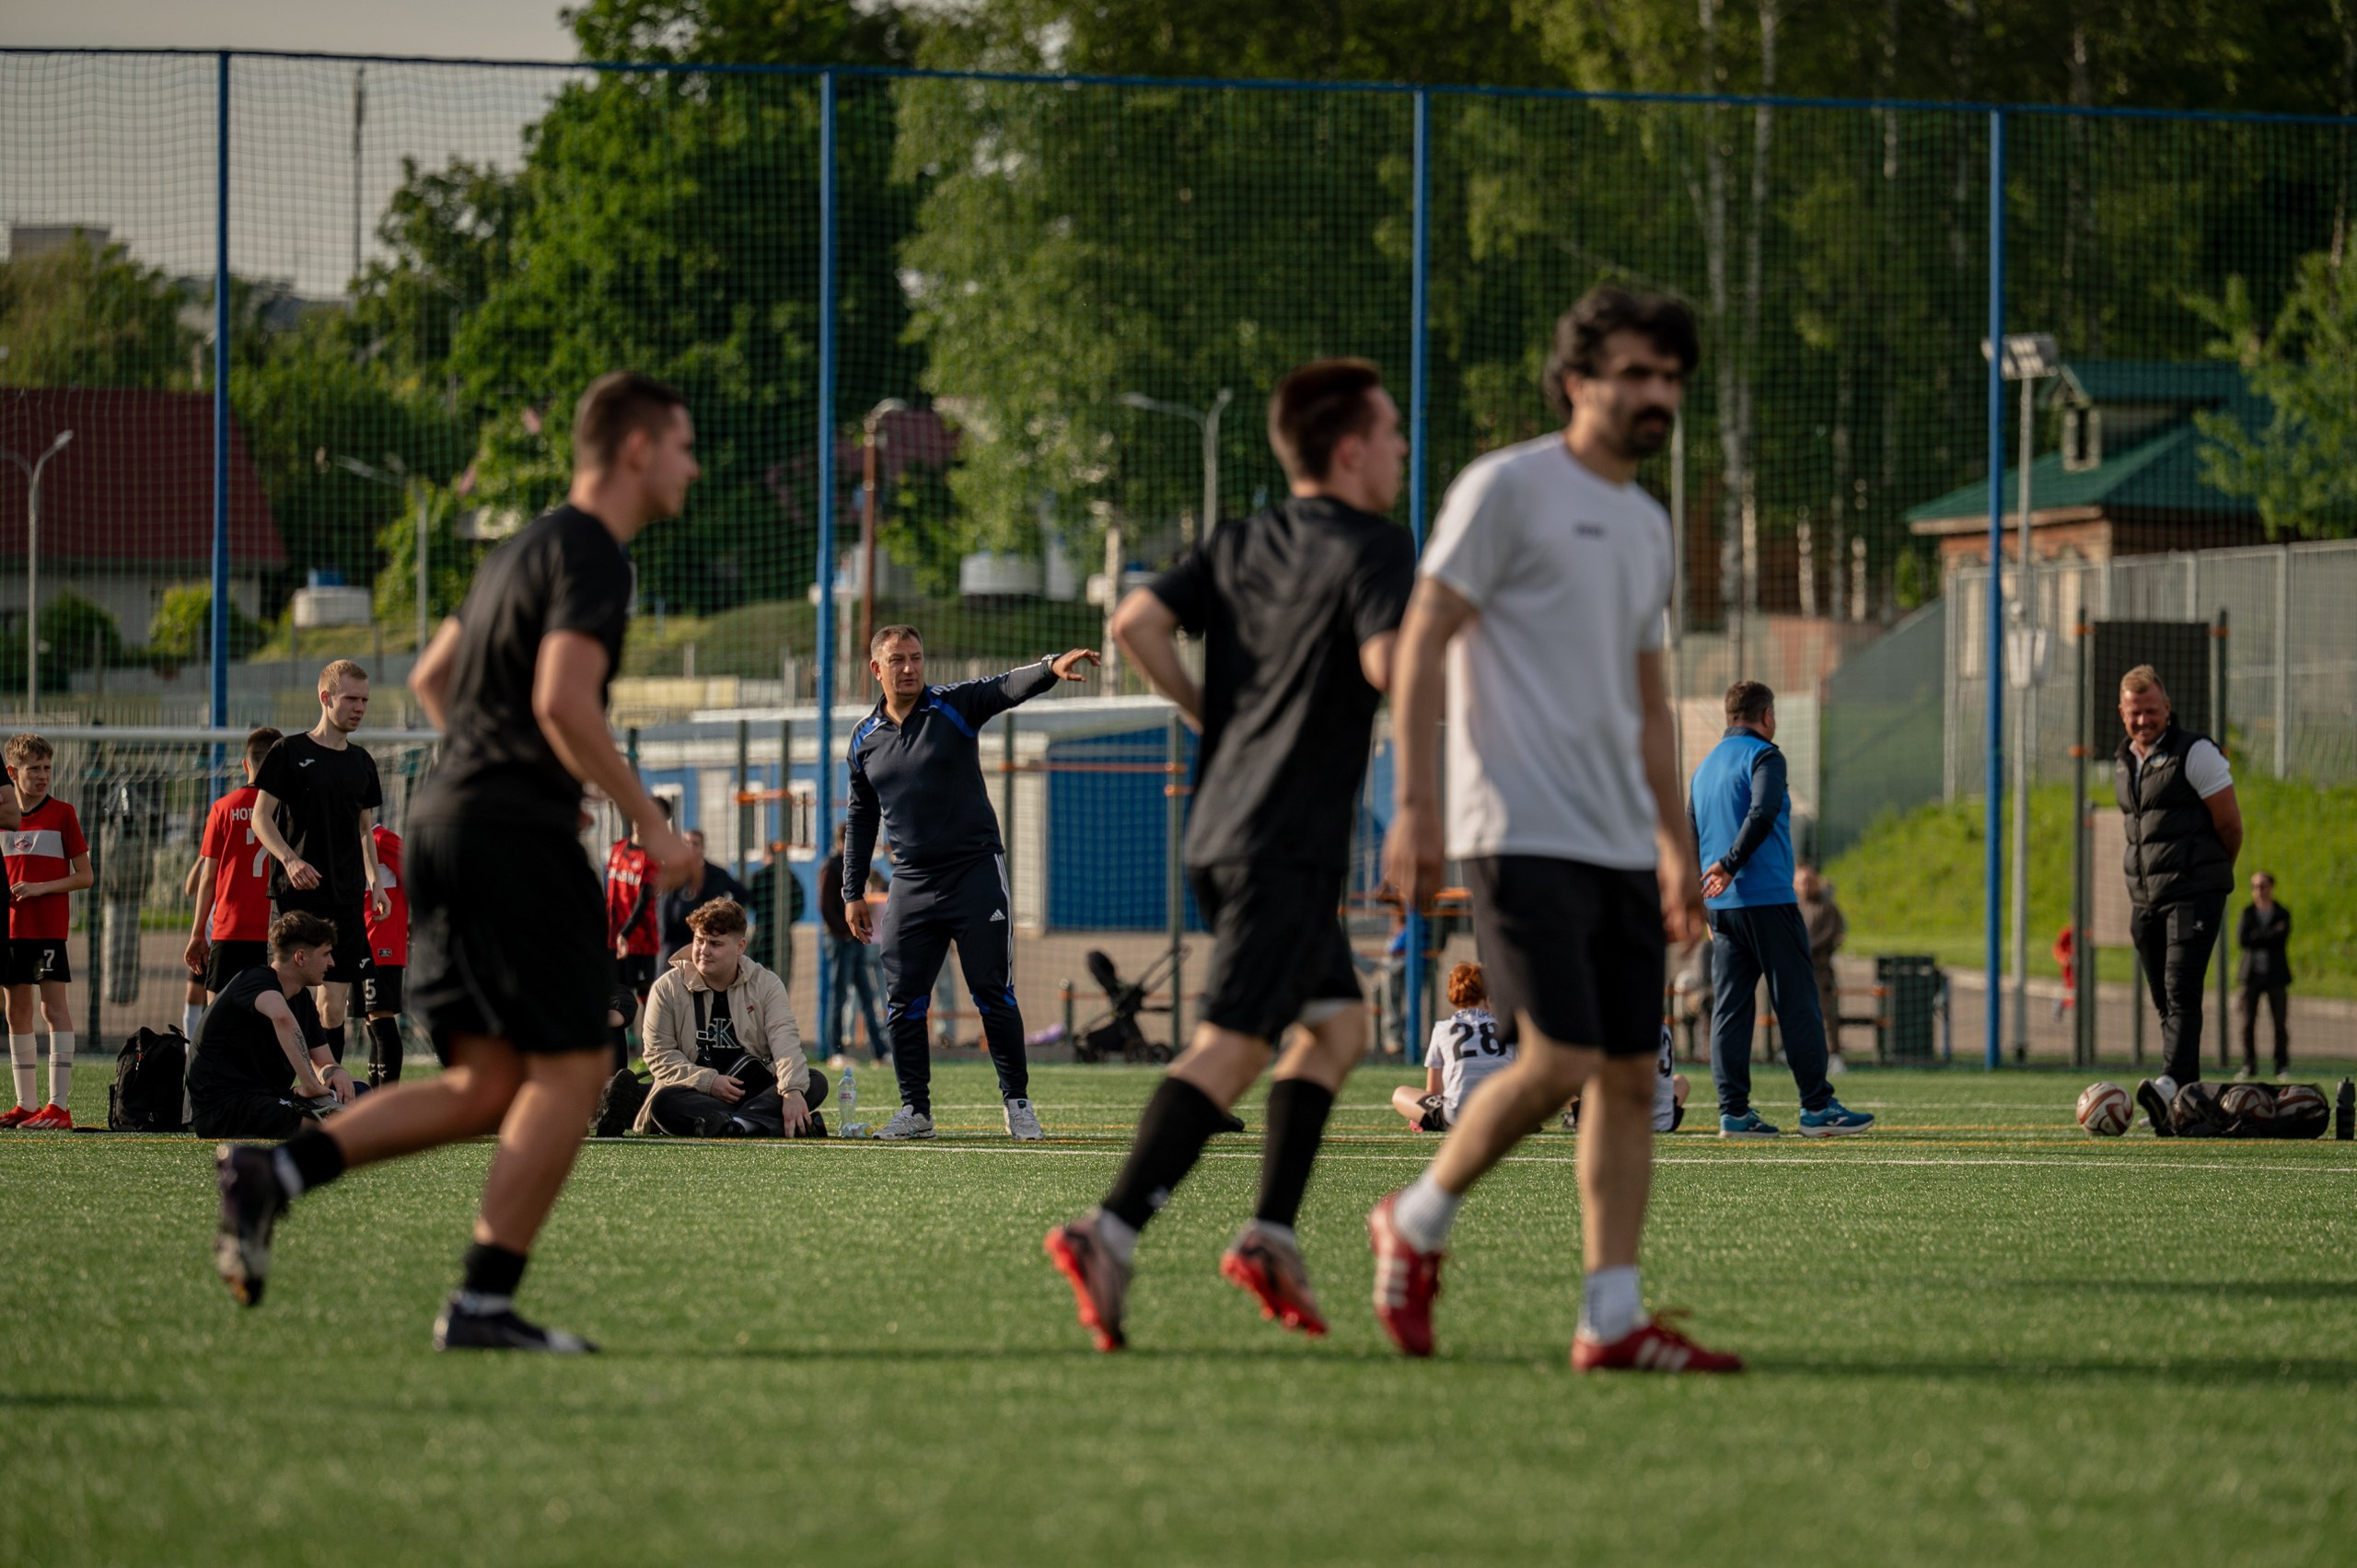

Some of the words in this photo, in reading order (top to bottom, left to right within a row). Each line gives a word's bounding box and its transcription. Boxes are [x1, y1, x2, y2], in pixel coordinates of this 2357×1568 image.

[246, 827, 270, 877] 7
[43, 949, 55, 969] 7
[365, 978, 377, 1001] 5
[1449, 1021, 1507, 1063] 28
